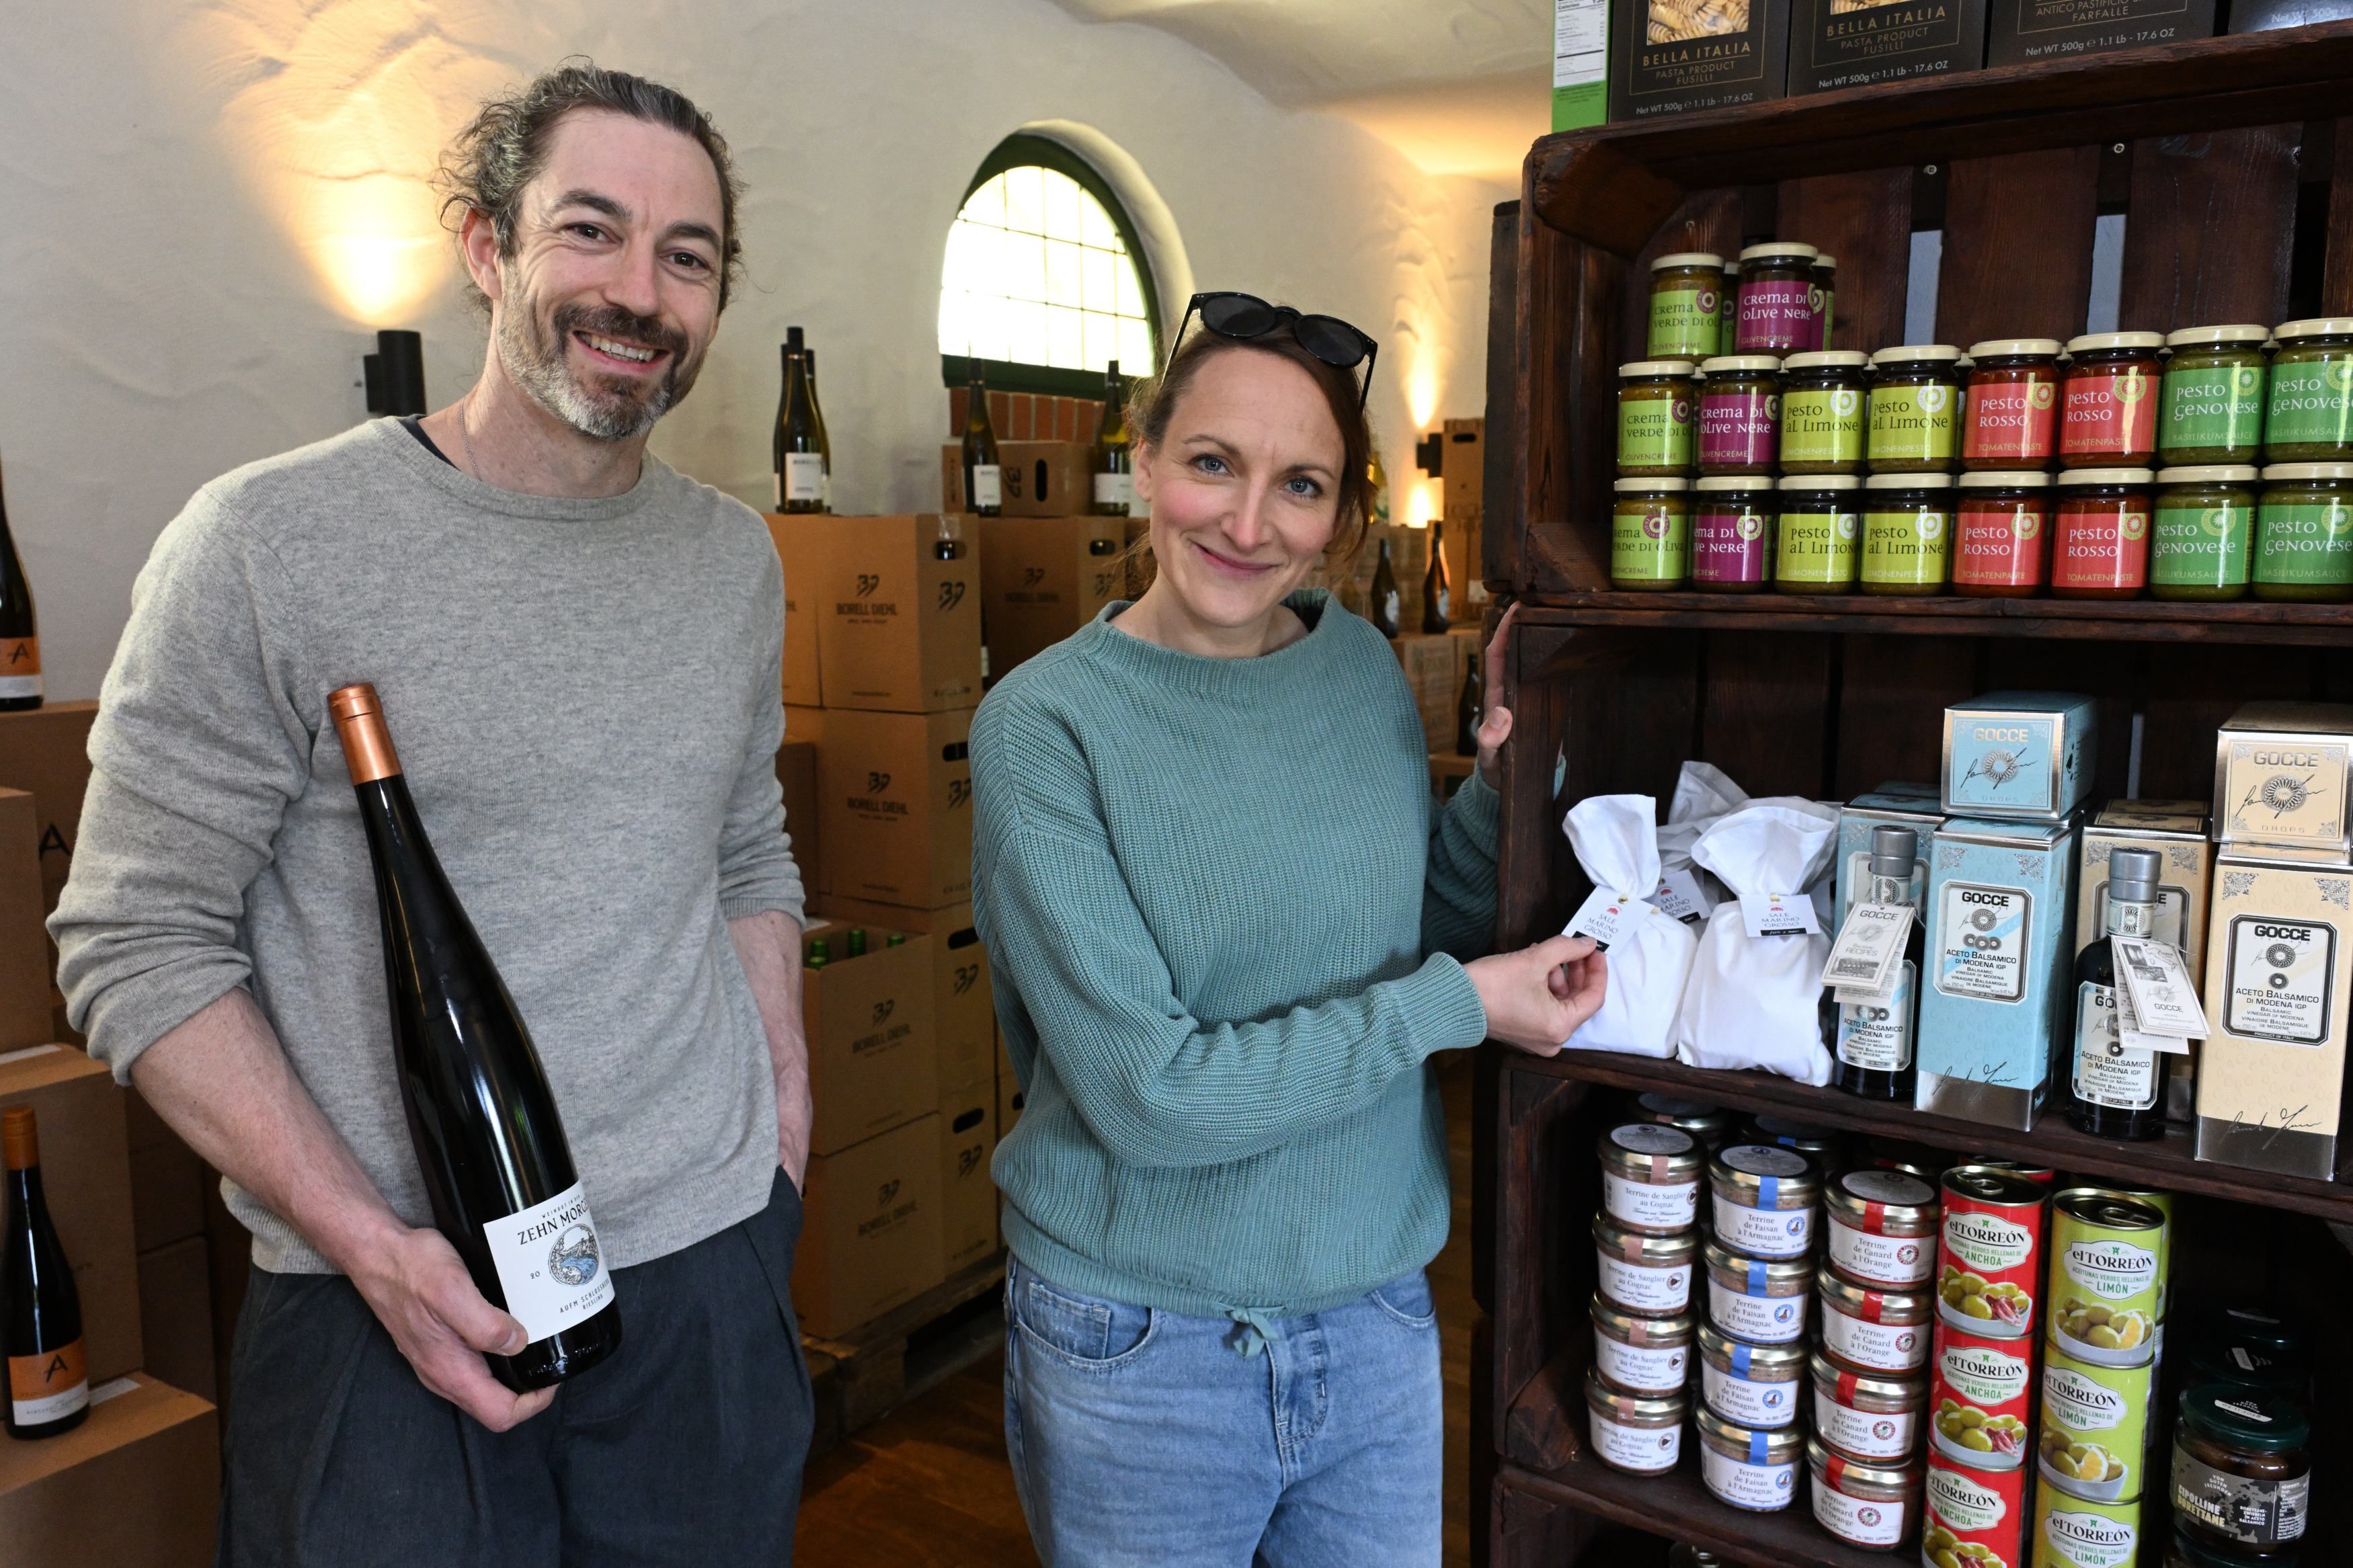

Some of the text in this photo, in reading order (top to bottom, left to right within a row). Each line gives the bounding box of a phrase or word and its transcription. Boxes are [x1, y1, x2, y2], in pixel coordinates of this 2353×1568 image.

[2036, 3, 2074, 17] ANTICO
[2073, 6, 2128, 22] FARFALLE
[1827, 5, 1946, 36] BELLA ITALIA
[1841, 27, 1929, 49] PASTA PRODUCT
[1643, 42, 1750, 67] BELLA ITALIA
[1864, 42, 1903, 54] FUSILLI
[1656, 61, 1735, 79] PASTA PRODUCT
[1834, 77, 1847, 85] WT
[1849, 74, 1869, 83] 500g
[1882, 69, 1894, 78] 1.1
[1897, 67, 1906, 76] Lb
[1915, 64, 1933, 73] 17.6
[1935, 60, 1948, 69] OZ
[1677, 74, 1712, 85] FUSILLI
[1796, 294, 1806, 304] DI
[1974, 728, 2028, 742] GOCCE
[2254, 751, 2319, 767] GOCCE
[1962, 892, 2009, 907] GOCCE
[1860, 911, 1899, 920] GOCCE
[1584, 924, 1612, 940] GROSSO
[1587, 917, 1619, 934] MARINO
[2255, 925, 2311, 941] GOCCE
[1845, 948, 1878, 956] RECIPES
[1946, 949, 1969, 957] ACETO
[1963, 960, 1994, 968] MODENA
[2236, 988, 2264, 997] ACETO
[2155, 1003, 2183, 1012] GOCCE
[2256, 998, 2292, 1008] MODENA
[1844, 1018, 1860, 1027] ACETO
[1856, 1029, 1882, 1038] MODENA
[2081, 1050, 2102, 1062] ACETO
[1748, 1214, 1775, 1223] Terrine
[518, 1218, 558, 1245] ZEHN
[1755, 1224, 1778, 1232] Faisan
[1859, 1237, 1886, 1249] Terrine
[1853, 1245, 1892, 1259] de Canard
[1965, 1251, 2002, 1266] ANCHOA
[2073, 1266, 2098, 1278] ACEITUNAS
[2098, 1282, 2128, 1294] LIMÓN
[560, 1301, 578, 1313] AUFM
[1965, 1385, 2001, 1399] ANCHOA
[2059, 1408, 2087, 1426] LIMÓN
[2178, 1485, 2220, 1516] CIPOLLINE
[1939, 1505, 1972, 1526] ANCHOA
[2075, 1551, 2106, 1565] LIMÓN
